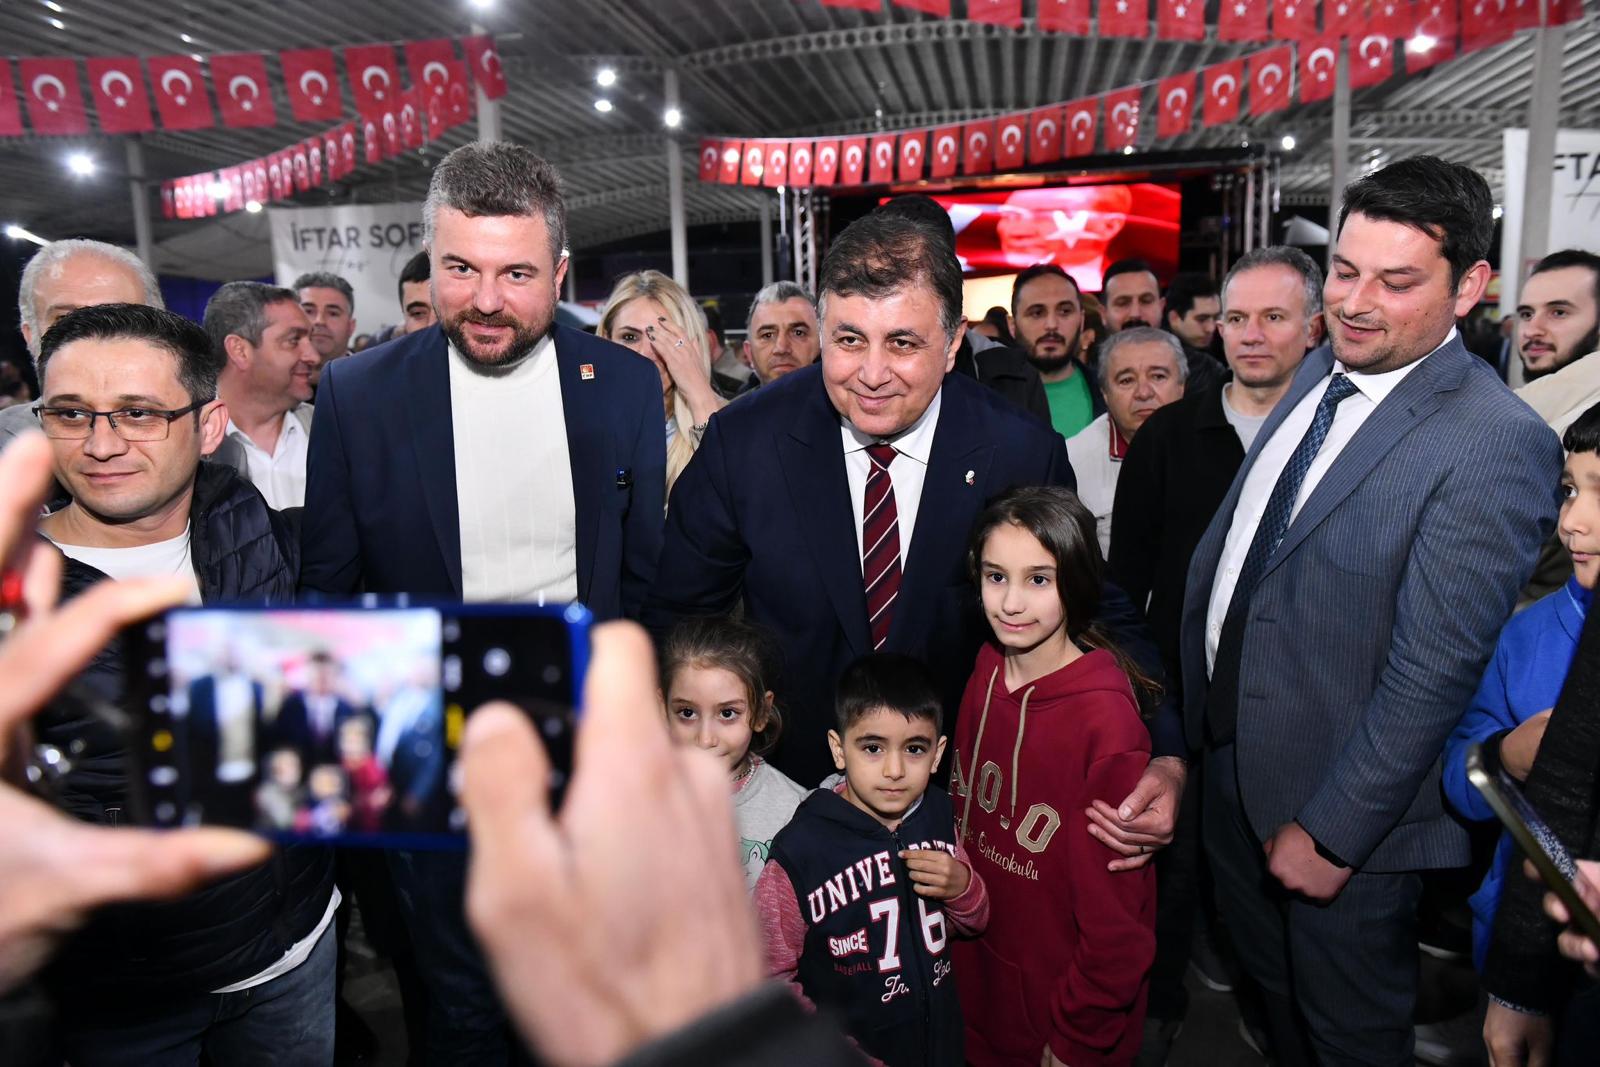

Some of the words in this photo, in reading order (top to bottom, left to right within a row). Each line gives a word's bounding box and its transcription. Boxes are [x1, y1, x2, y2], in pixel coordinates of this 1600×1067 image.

[290, 222, 361, 251] İFTAR
[369, 223, 425, 249] SOF
[978, 831, 1040, 881] Ortaokulu
[829, 927, 870, 958] SINCE
